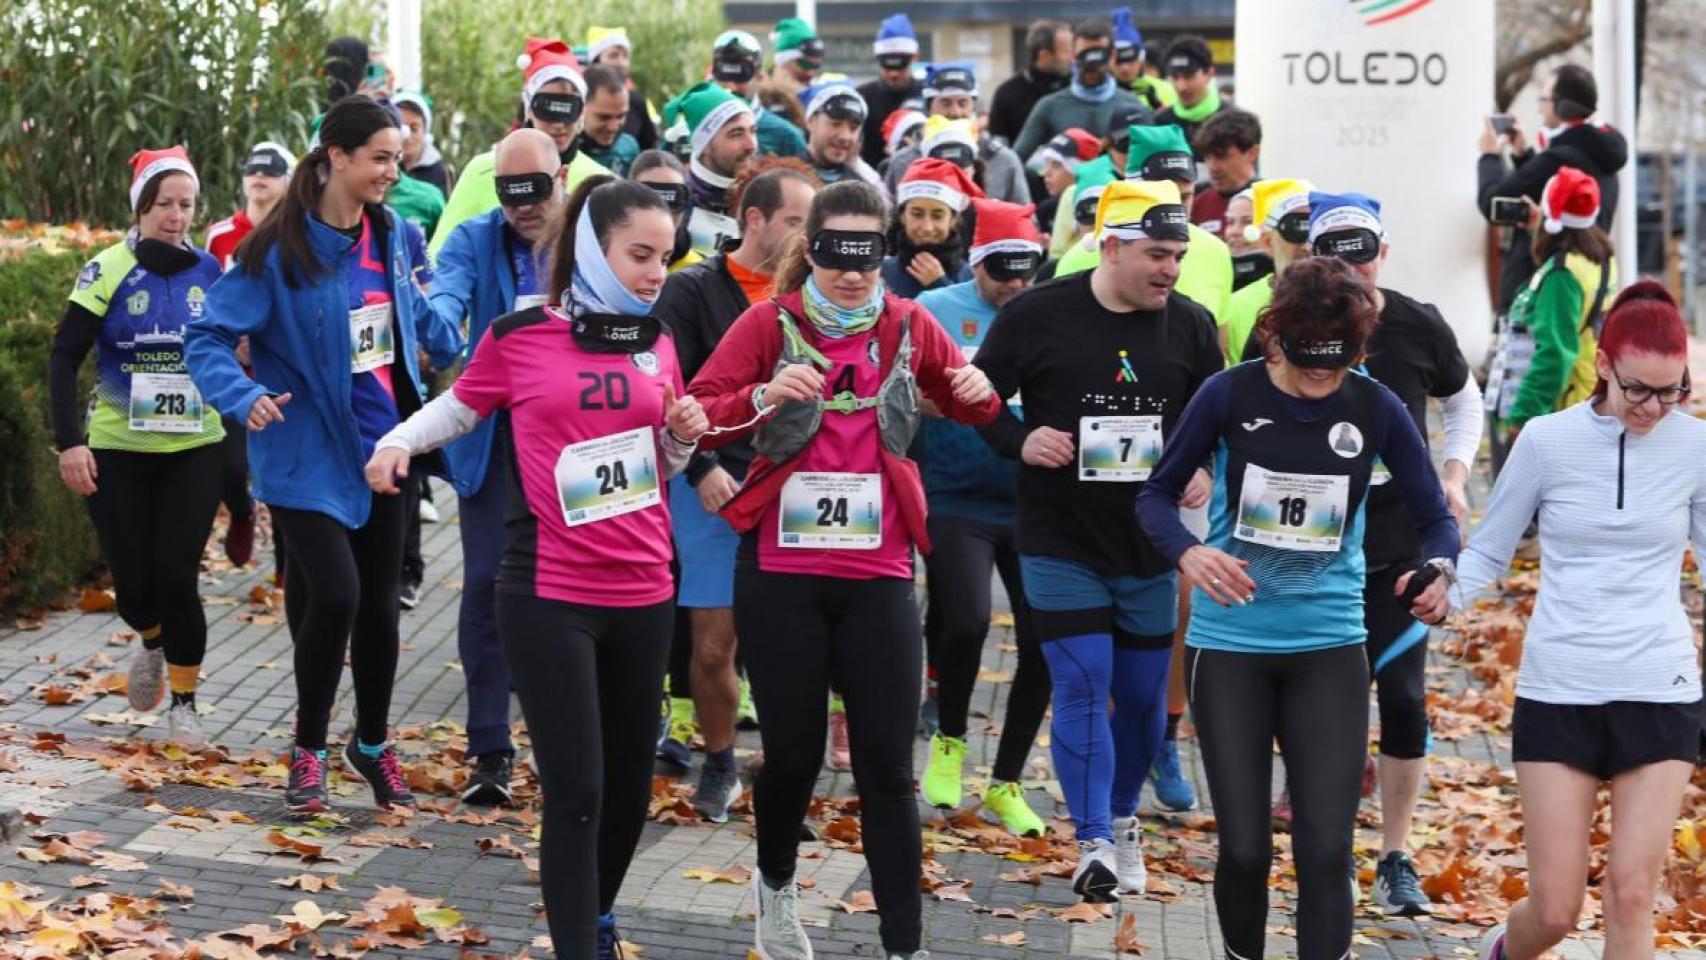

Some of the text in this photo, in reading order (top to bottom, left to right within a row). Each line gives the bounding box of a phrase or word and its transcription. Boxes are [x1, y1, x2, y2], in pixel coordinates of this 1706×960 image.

[1282, 51, 1447, 85] TOLEDO
[1336, 125, 1390, 147] 2025
[841, 247, 871, 256] ONCE
[358, 326, 374, 353] 29
[610, 331, 639, 340] ONCE
[135, 352, 180, 362] TOLEDO
[1310, 345, 1342, 354] ONCE
[577, 372, 630, 410] 20
[154, 393, 186, 415] 213
[1119, 438, 1133, 463] 7
[596, 460, 628, 495] 24
[816, 497, 849, 528] 24
[1279, 497, 1307, 527] 18
